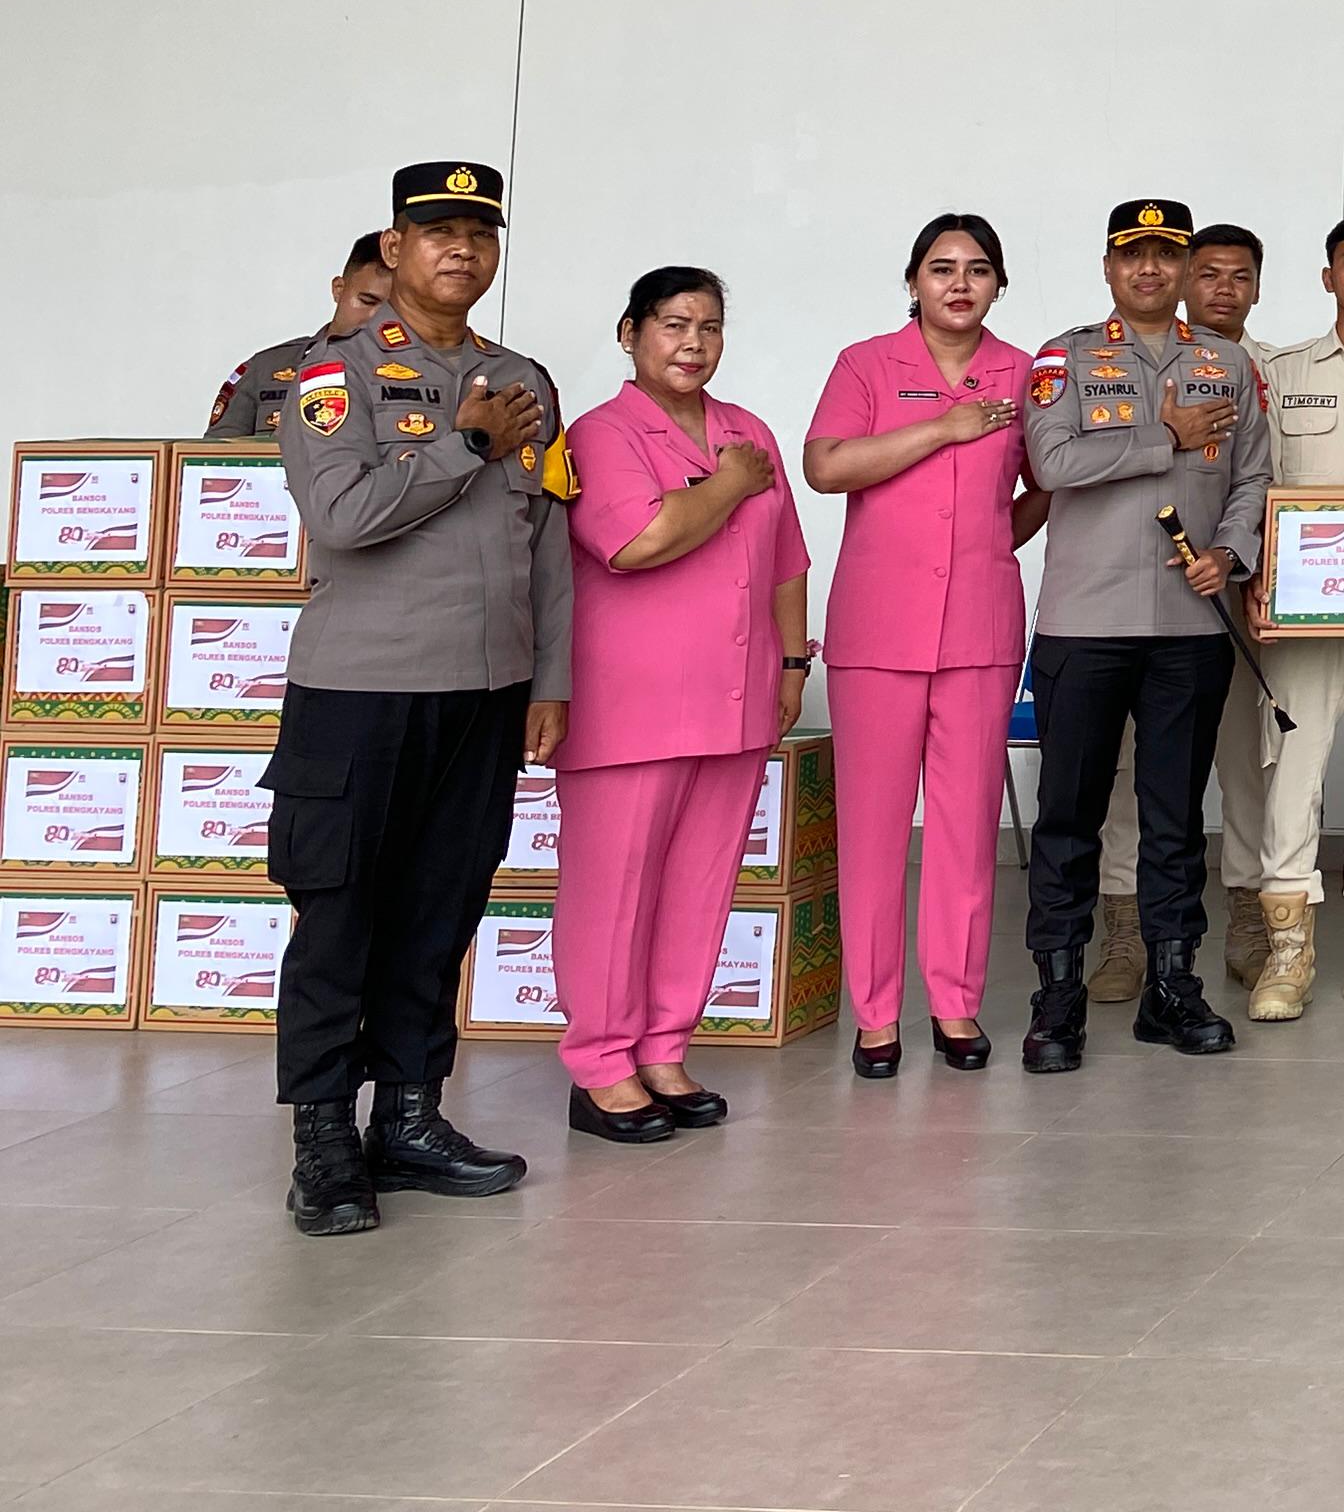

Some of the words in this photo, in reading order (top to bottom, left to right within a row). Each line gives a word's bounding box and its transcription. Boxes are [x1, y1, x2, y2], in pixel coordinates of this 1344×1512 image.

[1084, 383, 1138, 397] SYAHRUL
[1186, 383, 1235, 399] POLRI
[1286, 397, 1333, 407] TIMOTHY
[76, 507, 136, 515] BENGKAYANG
[201, 513, 231, 521] POLRES
[233, 513, 287, 522] BENGKAYANG
[1302, 558, 1339, 566] POLRES
[69, 625, 102, 633] BANSOS
[72, 638, 133, 646] BENGKAYANG
[192, 653, 226, 661] POLRES
[228, 654, 286, 662] BENGKAYANG
[58, 793, 93, 801] BANSOS
[183, 800, 217, 808] POLRES
[27, 805, 60, 813] POLRES
[62, 806, 123, 815] BENGKAYANG
[53, 947, 114, 956] BENGKAYANG
[177, 950, 212, 958] POLRES
[214, 951, 274, 960] BENGKAYANG
